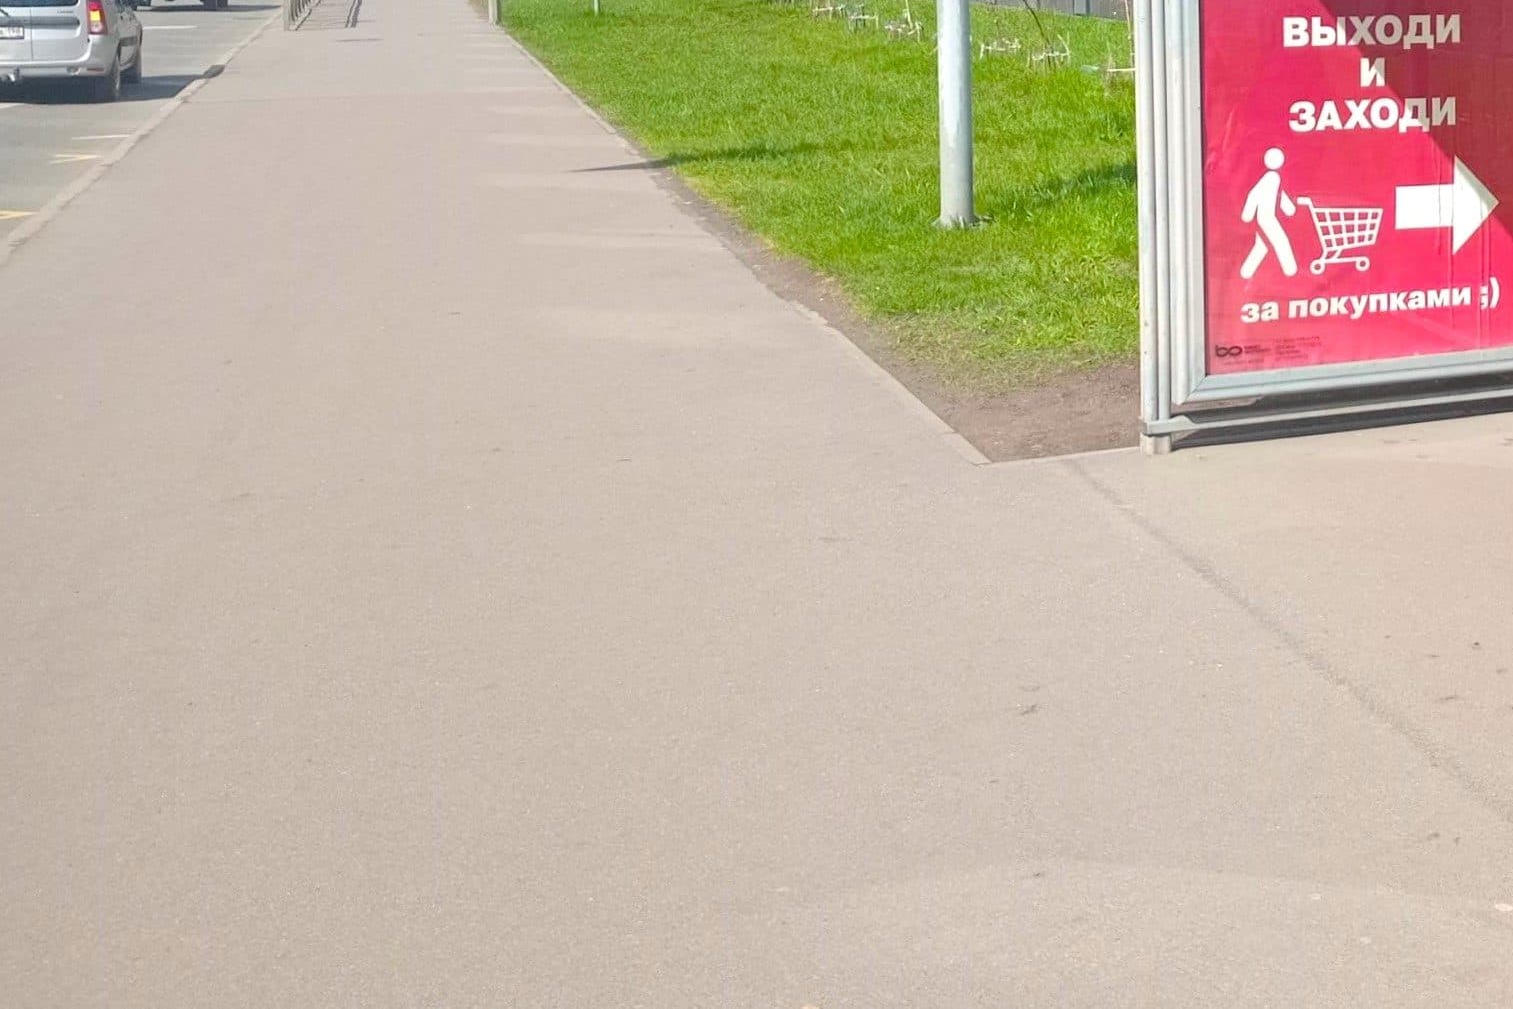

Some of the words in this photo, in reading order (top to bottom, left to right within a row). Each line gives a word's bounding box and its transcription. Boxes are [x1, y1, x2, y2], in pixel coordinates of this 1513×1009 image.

[1282, 14, 1461, 50] ВЫХОДИ
[1360, 57, 1385, 88] И
[1288, 96, 1457, 133] ЗАХОДИ
[1240, 300, 1279, 323] за
[1288, 286, 1471, 319] покупками
